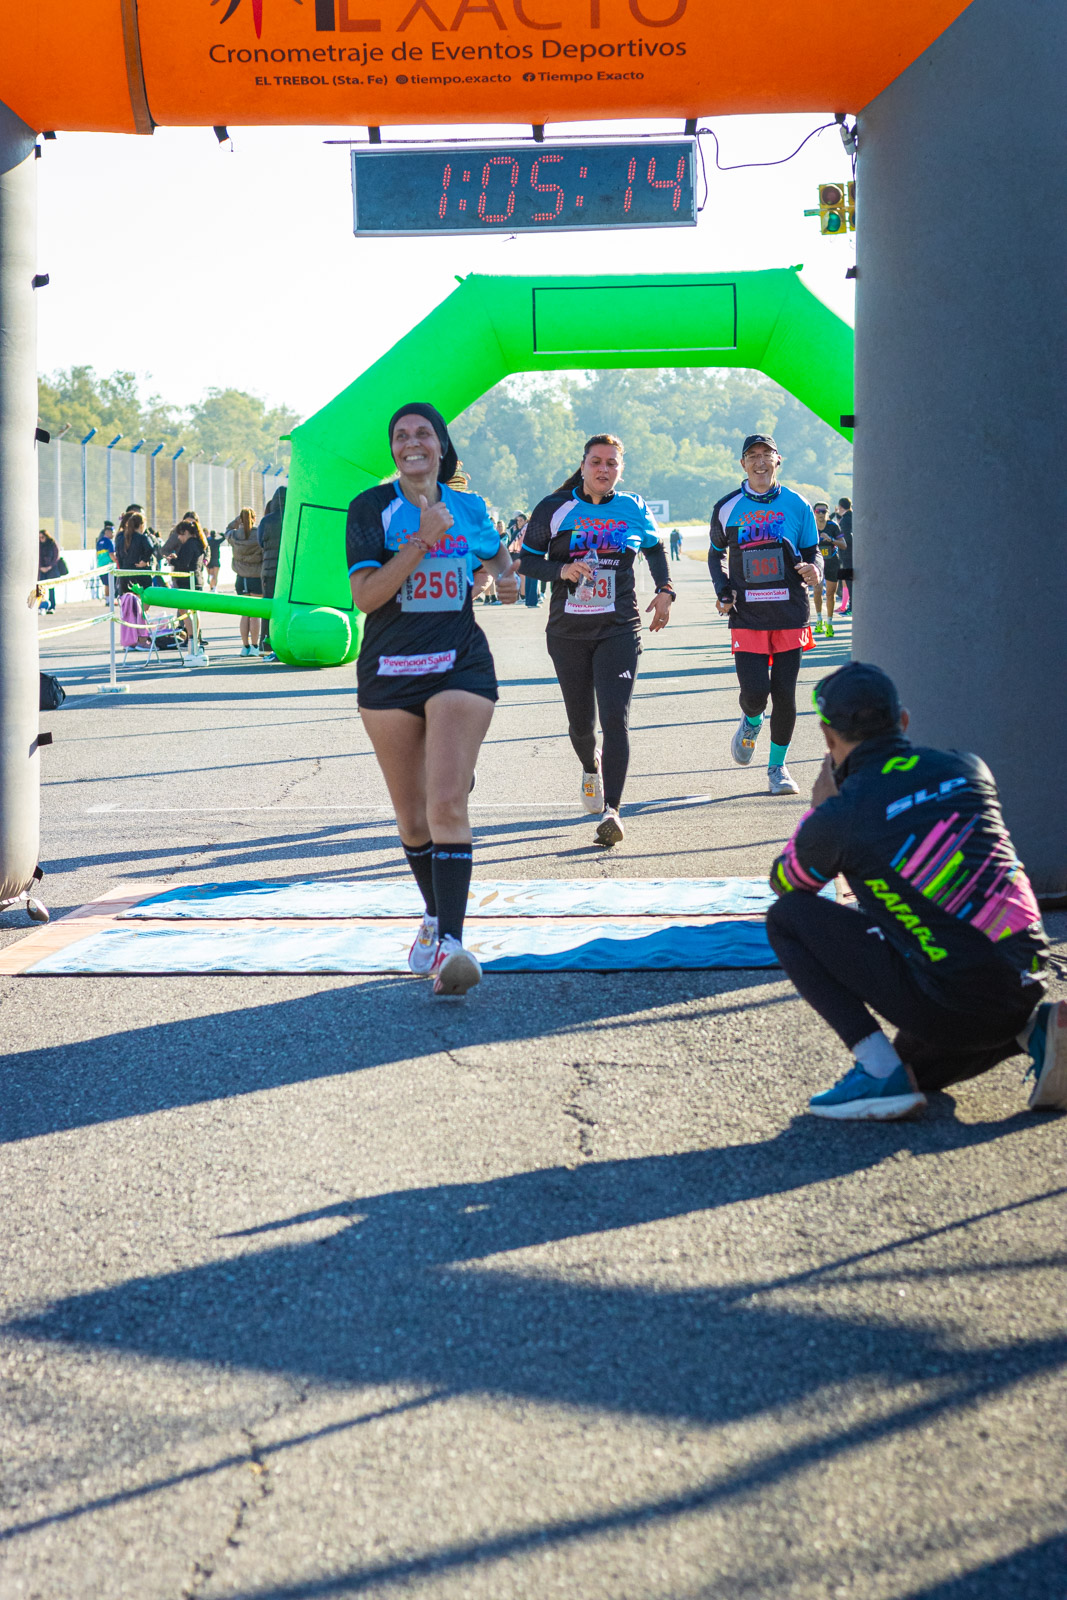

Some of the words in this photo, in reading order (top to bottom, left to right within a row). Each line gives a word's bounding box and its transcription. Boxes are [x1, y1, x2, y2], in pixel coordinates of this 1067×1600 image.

[209, 43, 384, 66] Cronometraje
[391, 41, 423, 61] de
[432, 41, 534, 60] Eventos
[542, 38, 687, 62] Deportivos
[255, 76, 271, 85] EL
[273, 75, 330, 85] TREBOL
[333, 75, 364, 86] (Sta.
[367, 74, 388, 85] Fe)
[411, 73, 511, 85] tiempo.exacto
[538, 72, 593, 83] Tiempo
[597, 70, 645, 81] Exacto
[752, 557, 778, 577] 363
[414, 571, 458, 599] 256
